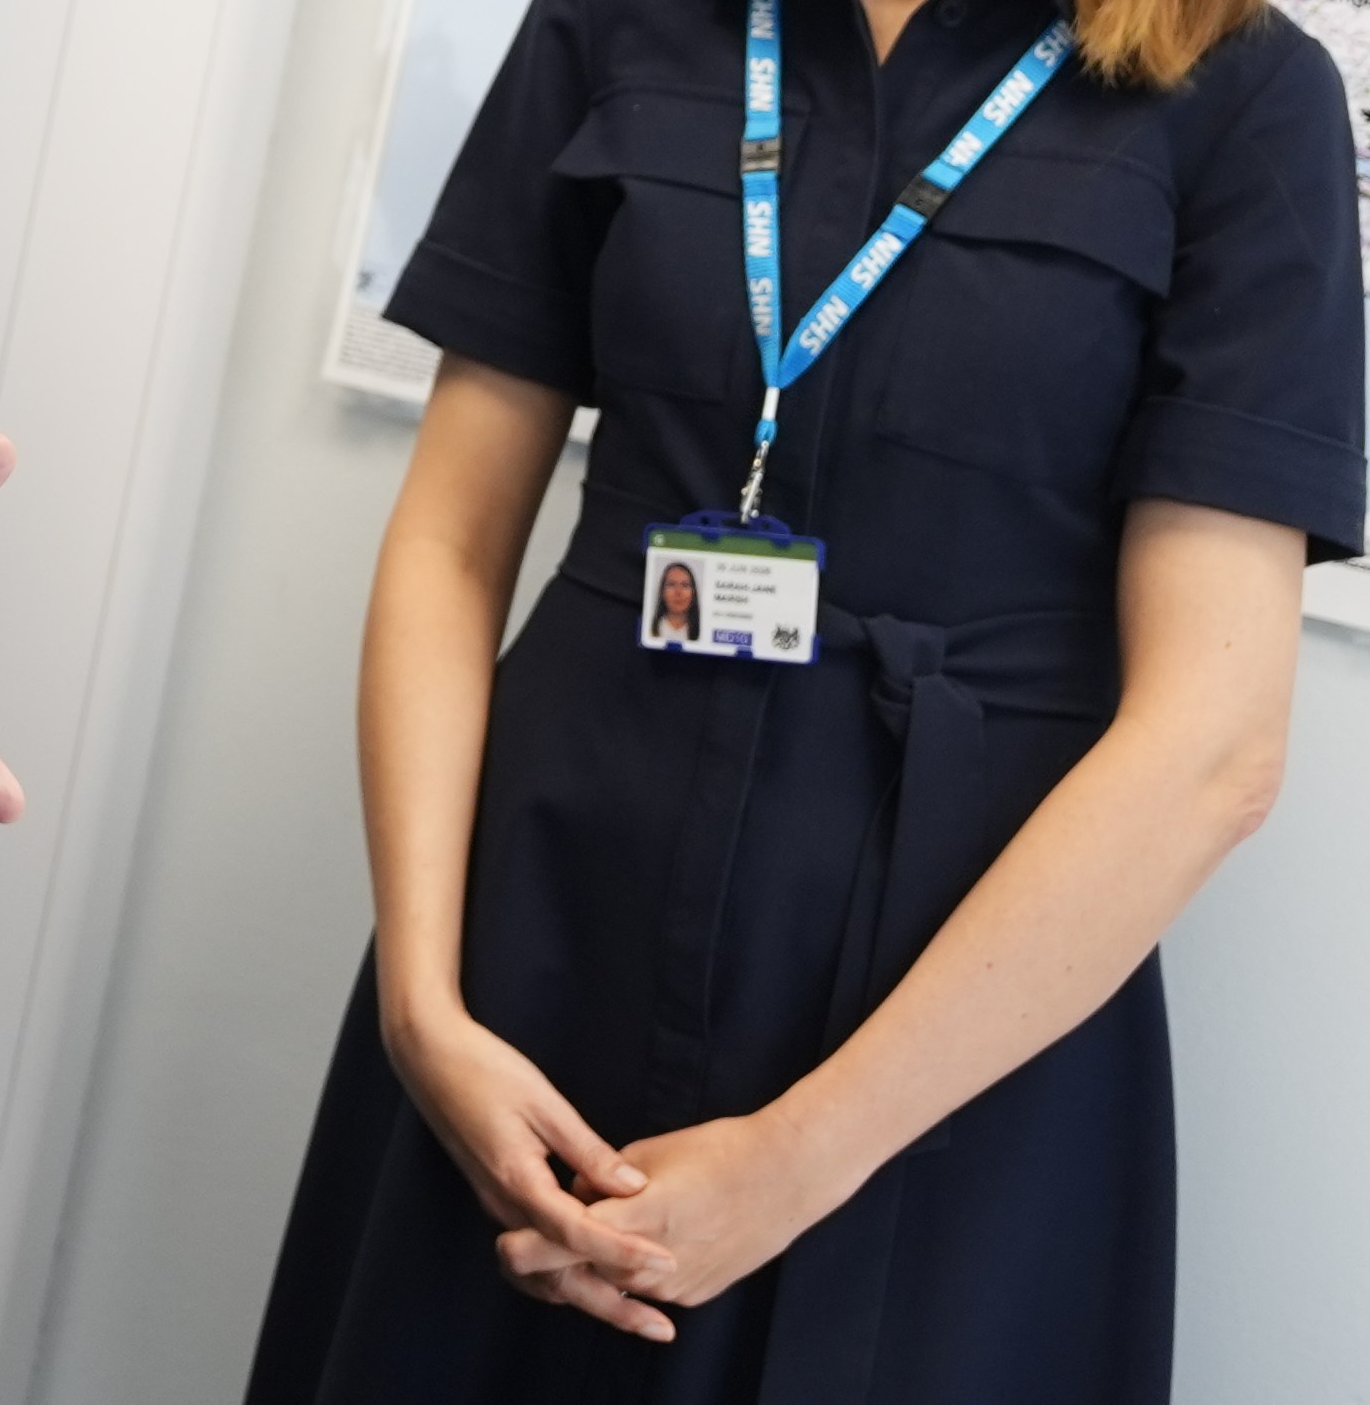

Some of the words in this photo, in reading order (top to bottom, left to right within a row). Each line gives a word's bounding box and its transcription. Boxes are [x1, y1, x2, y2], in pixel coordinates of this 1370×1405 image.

[749, 57, 776, 112] NHS
[983, 70, 1034, 128] NHS
[747, 200, 774, 258] NHS
[851, 231, 903, 291] NHS
[749, 277, 774, 337] NHS
[798, 294, 850, 356] NHS
